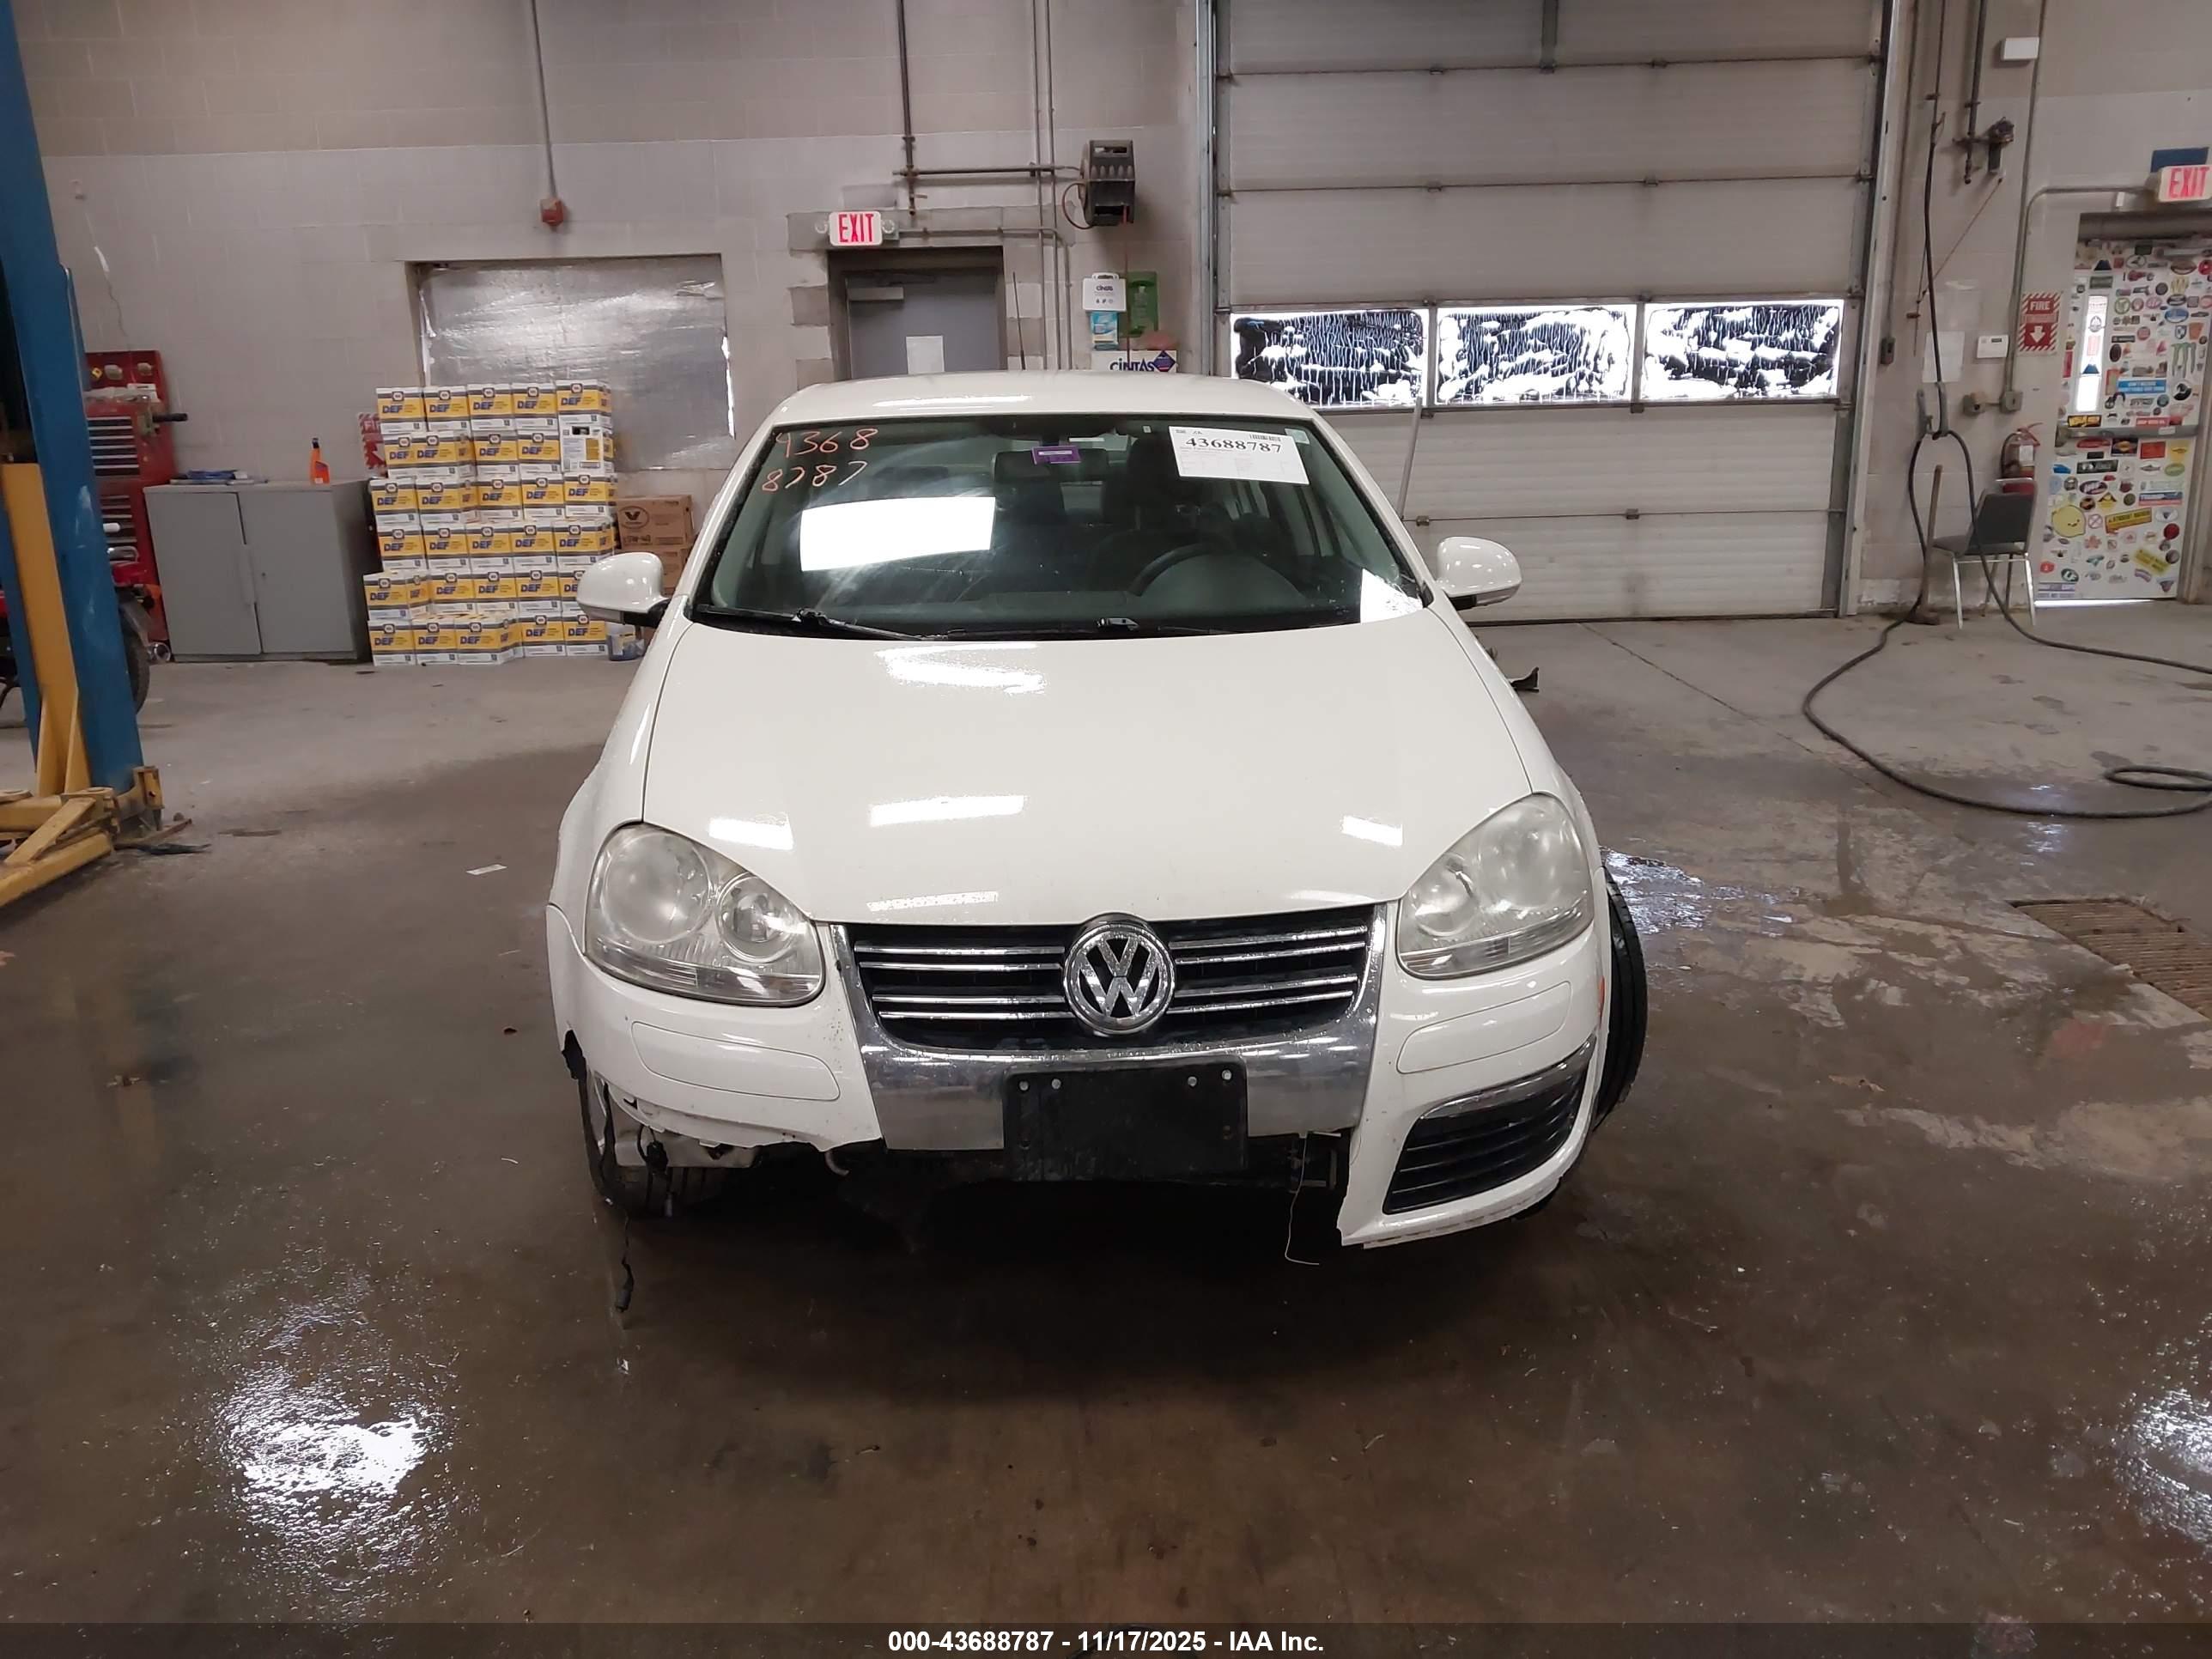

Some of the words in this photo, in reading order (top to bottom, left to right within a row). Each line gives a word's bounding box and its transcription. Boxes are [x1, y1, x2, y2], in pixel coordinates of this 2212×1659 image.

[2168, 167, 2209, 199] EXIT
[839, 213, 874, 243] EXIT
[2030, 301, 2051, 311] FIRE
[473, 402, 494, 410] DEF
[561, 397, 581, 406] DEF
[382, 404, 403, 413] DEF
[429, 404, 450, 412] DEF
[775, 428, 878, 459] 4368
[1186, 437, 1282, 453] 43688787
[389, 451, 409, 459] DEF
[417, 449, 438, 458] DEF
[479, 447, 500, 455] DEF
[522, 446, 542, 455] DEF
[762, 460, 868, 491] 8787
[483, 492, 501, 501] DEF
[526, 490, 545, 499] DEF
[568, 488, 588, 496] DEF
[377, 496, 397, 505] DEF
[422, 495, 441, 505] DEF
[384, 542, 404, 550] DEF
[429, 541, 449, 550] DEF
[472, 540, 492, 549] DEF
[515, 539, 535, 548] DEF
[559, 538, 580, 548] DEF
[436, 586, 456, 594] DEF
[478, 584, 499, 592] DEF
[521, 584, 541, 592] DEF
[564, 584, 577, 592] DE
[370, 592, 390, 600] DEF
[526, 629, 545, 637] DEF
[568, 628, 587, 636] DEF
[374, 636, 393, 645] DEF
[418, 636, 438, 645] DEF
[460, 635, 480, 644] DEF
